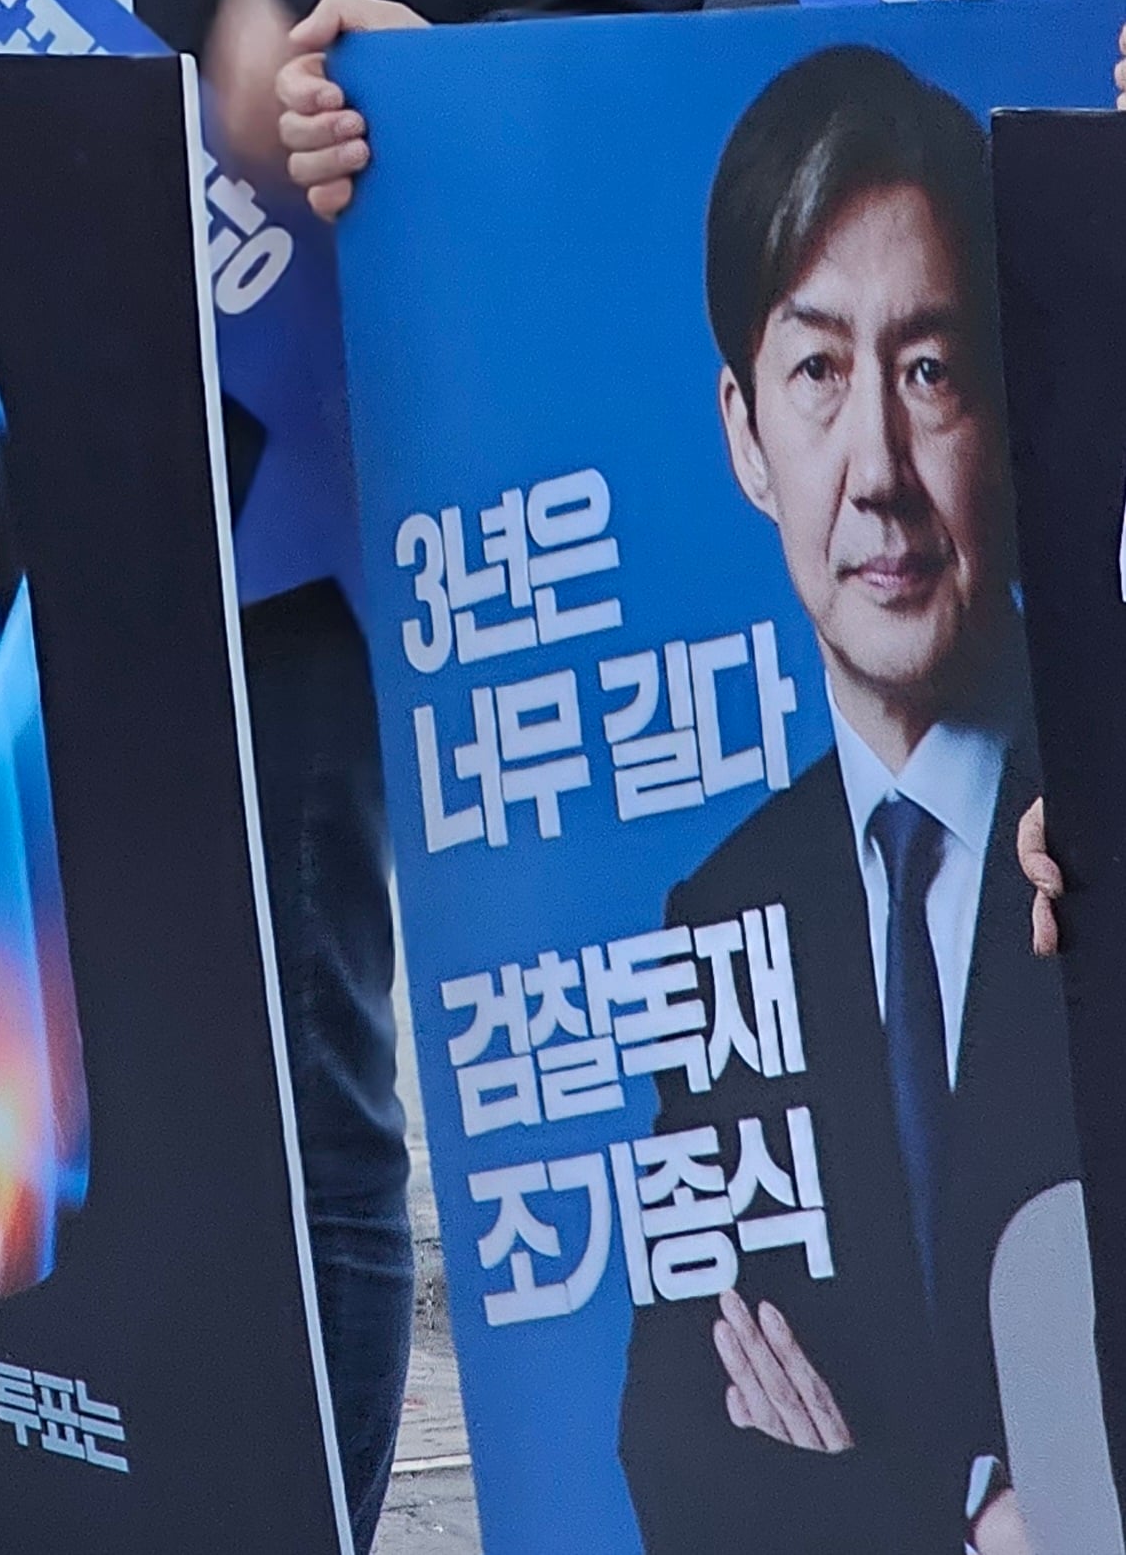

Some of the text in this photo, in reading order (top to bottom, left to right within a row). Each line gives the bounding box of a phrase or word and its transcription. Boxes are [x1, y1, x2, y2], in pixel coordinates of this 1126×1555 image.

[395, 467, 623, 674] 3년은
[413, 620, 798, 854] 너무 길다
